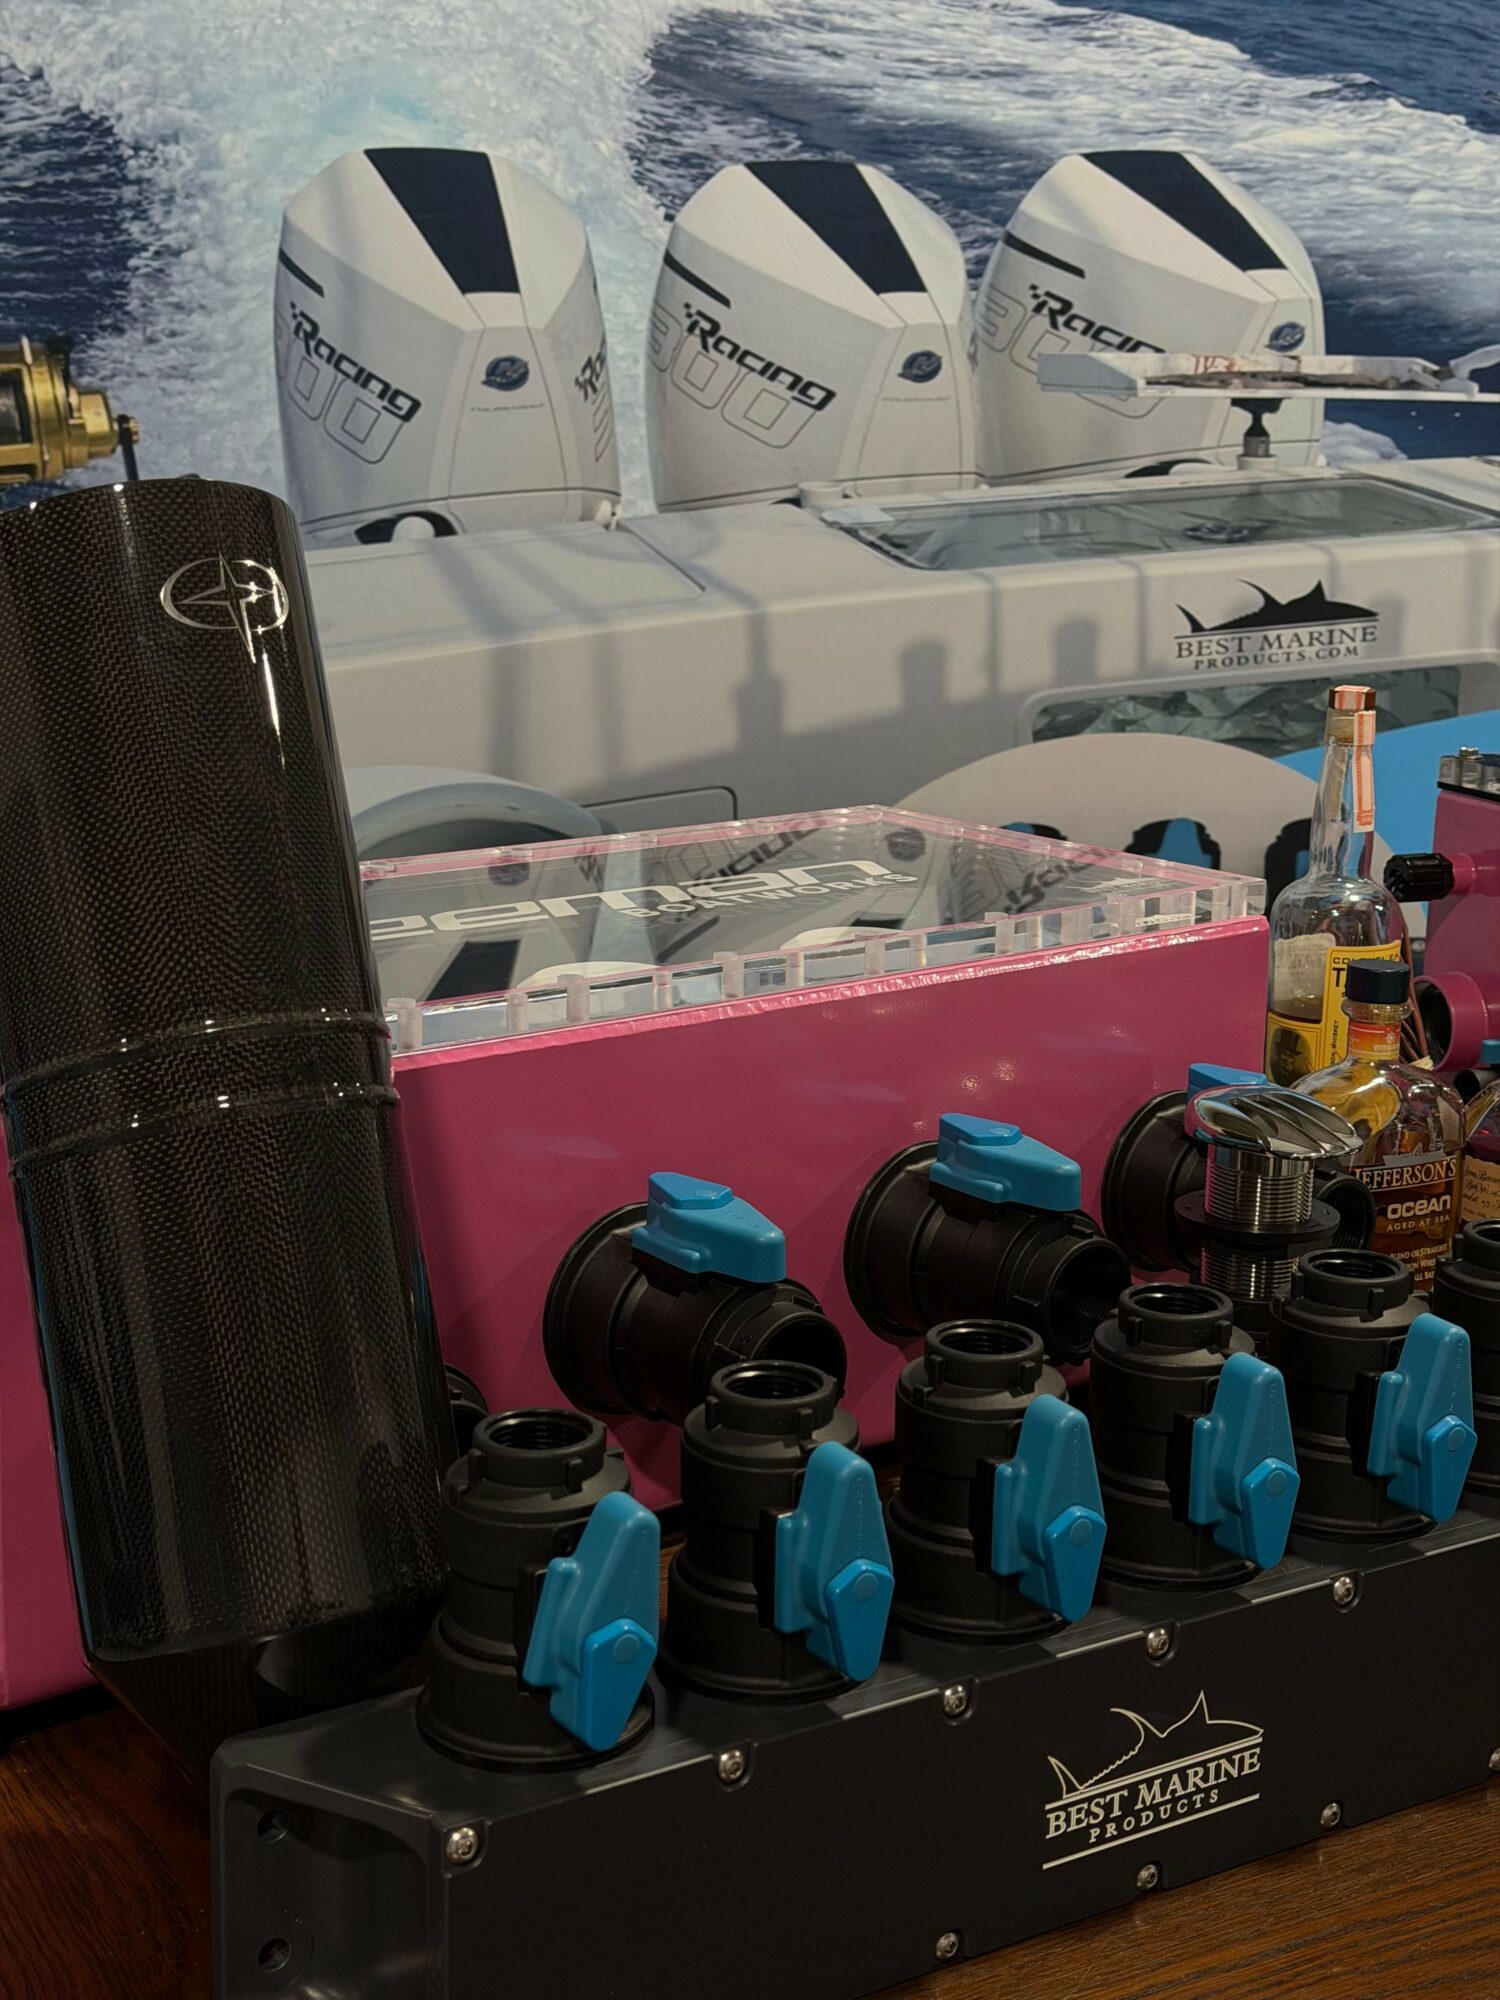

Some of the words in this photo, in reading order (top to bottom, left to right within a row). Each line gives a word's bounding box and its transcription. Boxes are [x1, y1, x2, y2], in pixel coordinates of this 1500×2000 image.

[292, 308, 422, 423] Racing
[685, 308, 837, 412] Racing
[1175, 635, 1252, 659] BEST
[1259, 625, 1378, 652] MARINE
[1194, 645, 1359, 670] PRODUCTS.COM
[617, 873, 919, 918] BOATWORKS
[1331, 1020, 1340, 1050] WHISKEY
[1355, 1156, 1457, 1189] JEFFERSON'S
[1386, 1221, 1416, 1232] AGED
[1419, 1218, 1431, 1227] AT
[1434, 1214, 1450, 1224] SEA
[1420, 1243, 1448, 1256] STRAIGHT
[1045, 1788, 1129, 1840] BEST
[1134, 1747, 1262, 1810] MARINE
[1088, 1788, 1219, 1844] PRODUCTS
